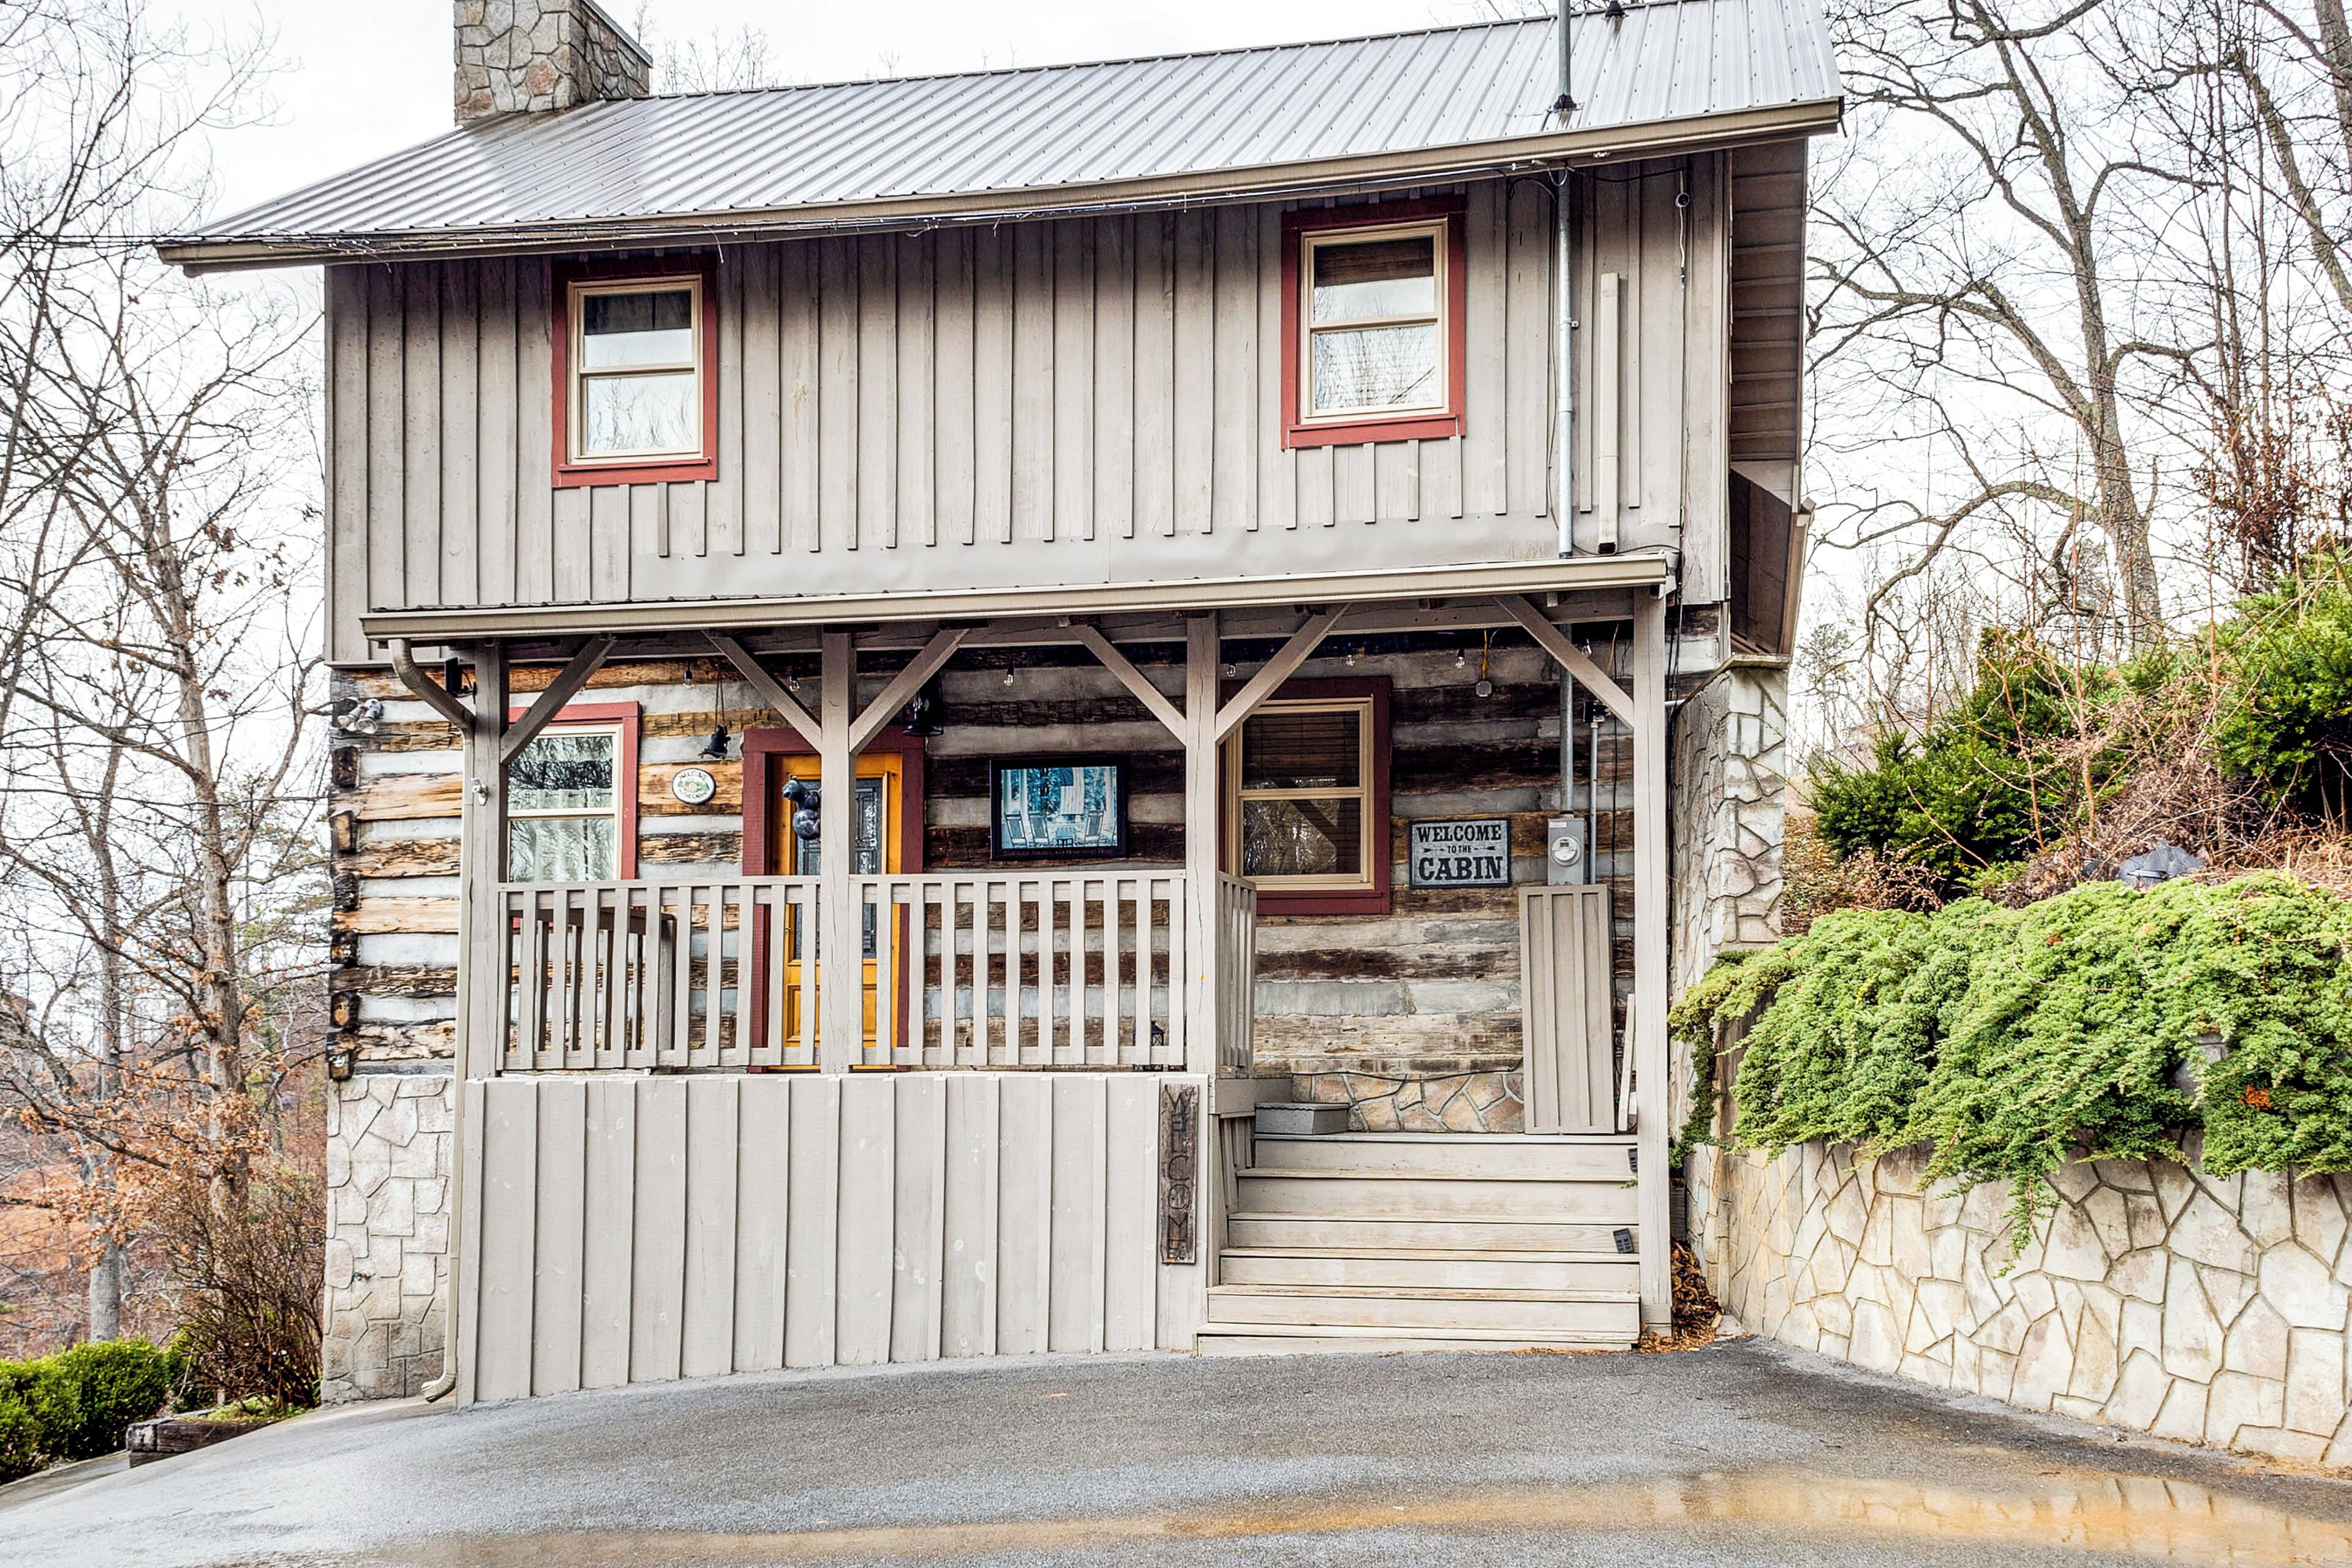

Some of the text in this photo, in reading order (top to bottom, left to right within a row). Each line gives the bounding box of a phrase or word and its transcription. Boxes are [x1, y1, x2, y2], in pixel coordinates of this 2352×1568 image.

[1417, 825, 1501, 842] WELCOME
[1447, 845, 1472, 853] TO THE
[1419, 856, 1503, 881] CABIN
[1164, 1084, 1194, 1261] WELCOME
